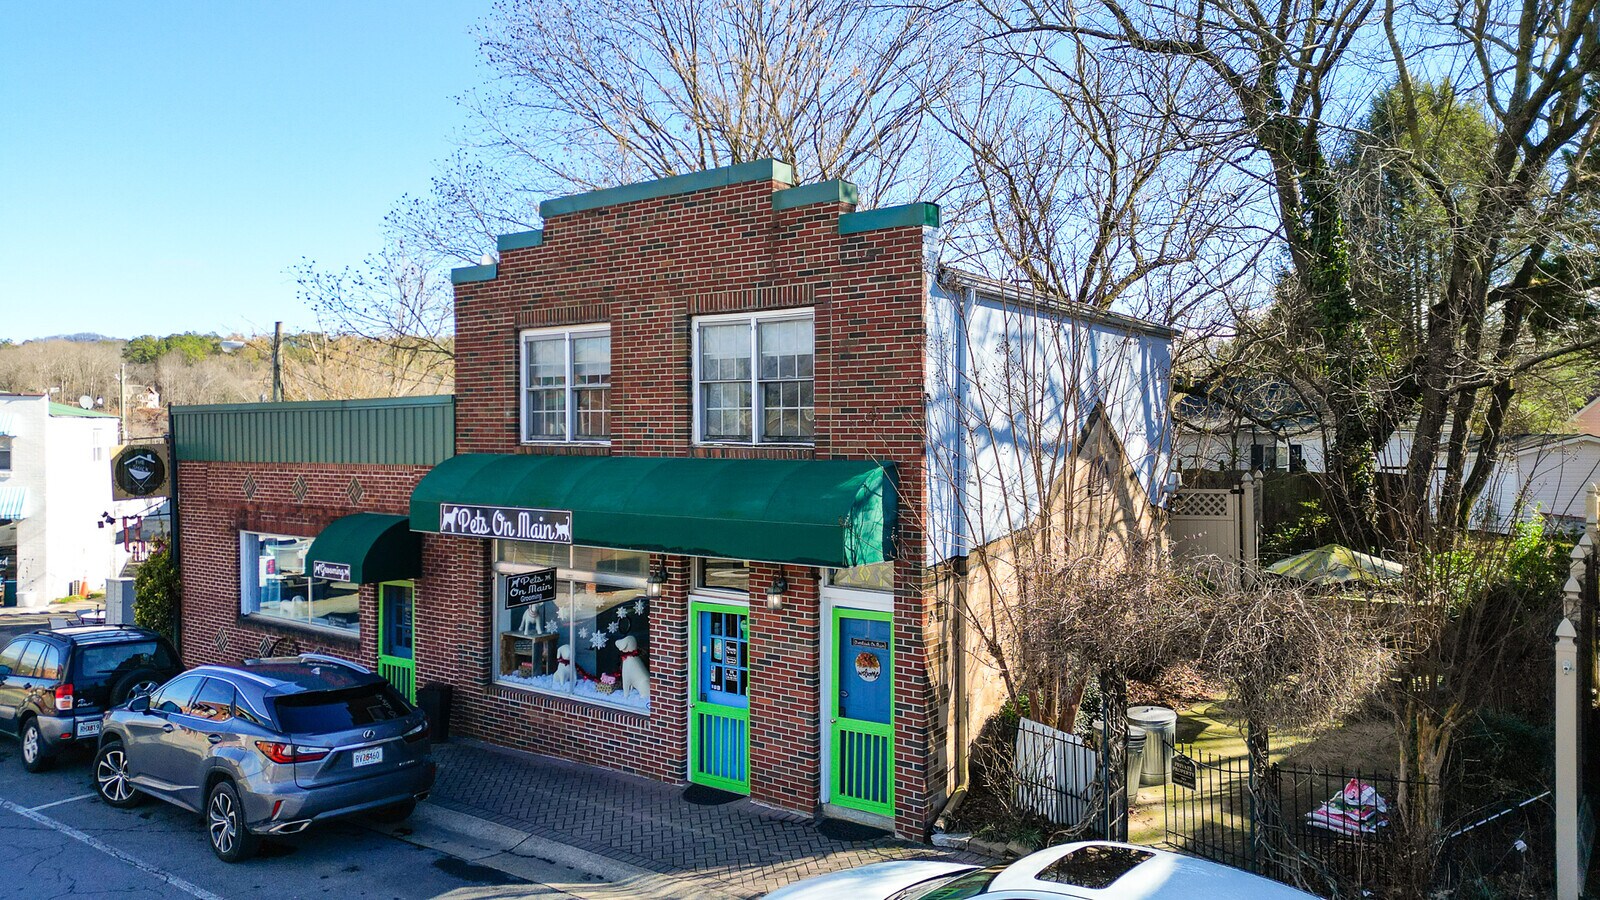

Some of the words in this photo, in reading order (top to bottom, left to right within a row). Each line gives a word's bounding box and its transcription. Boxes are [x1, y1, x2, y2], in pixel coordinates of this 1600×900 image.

[457, 508, 490, 534] Pets
[492, 509, 515, 537] On
[517, 511, 555, 540] Main
[320, 563, 344, 580] Grooming
[520, 574, 543, 586] Pets
[509, 588, 526, 597] On
[528, 583, 553, 594] Main
[520, 593, 542, 603] Grooming
